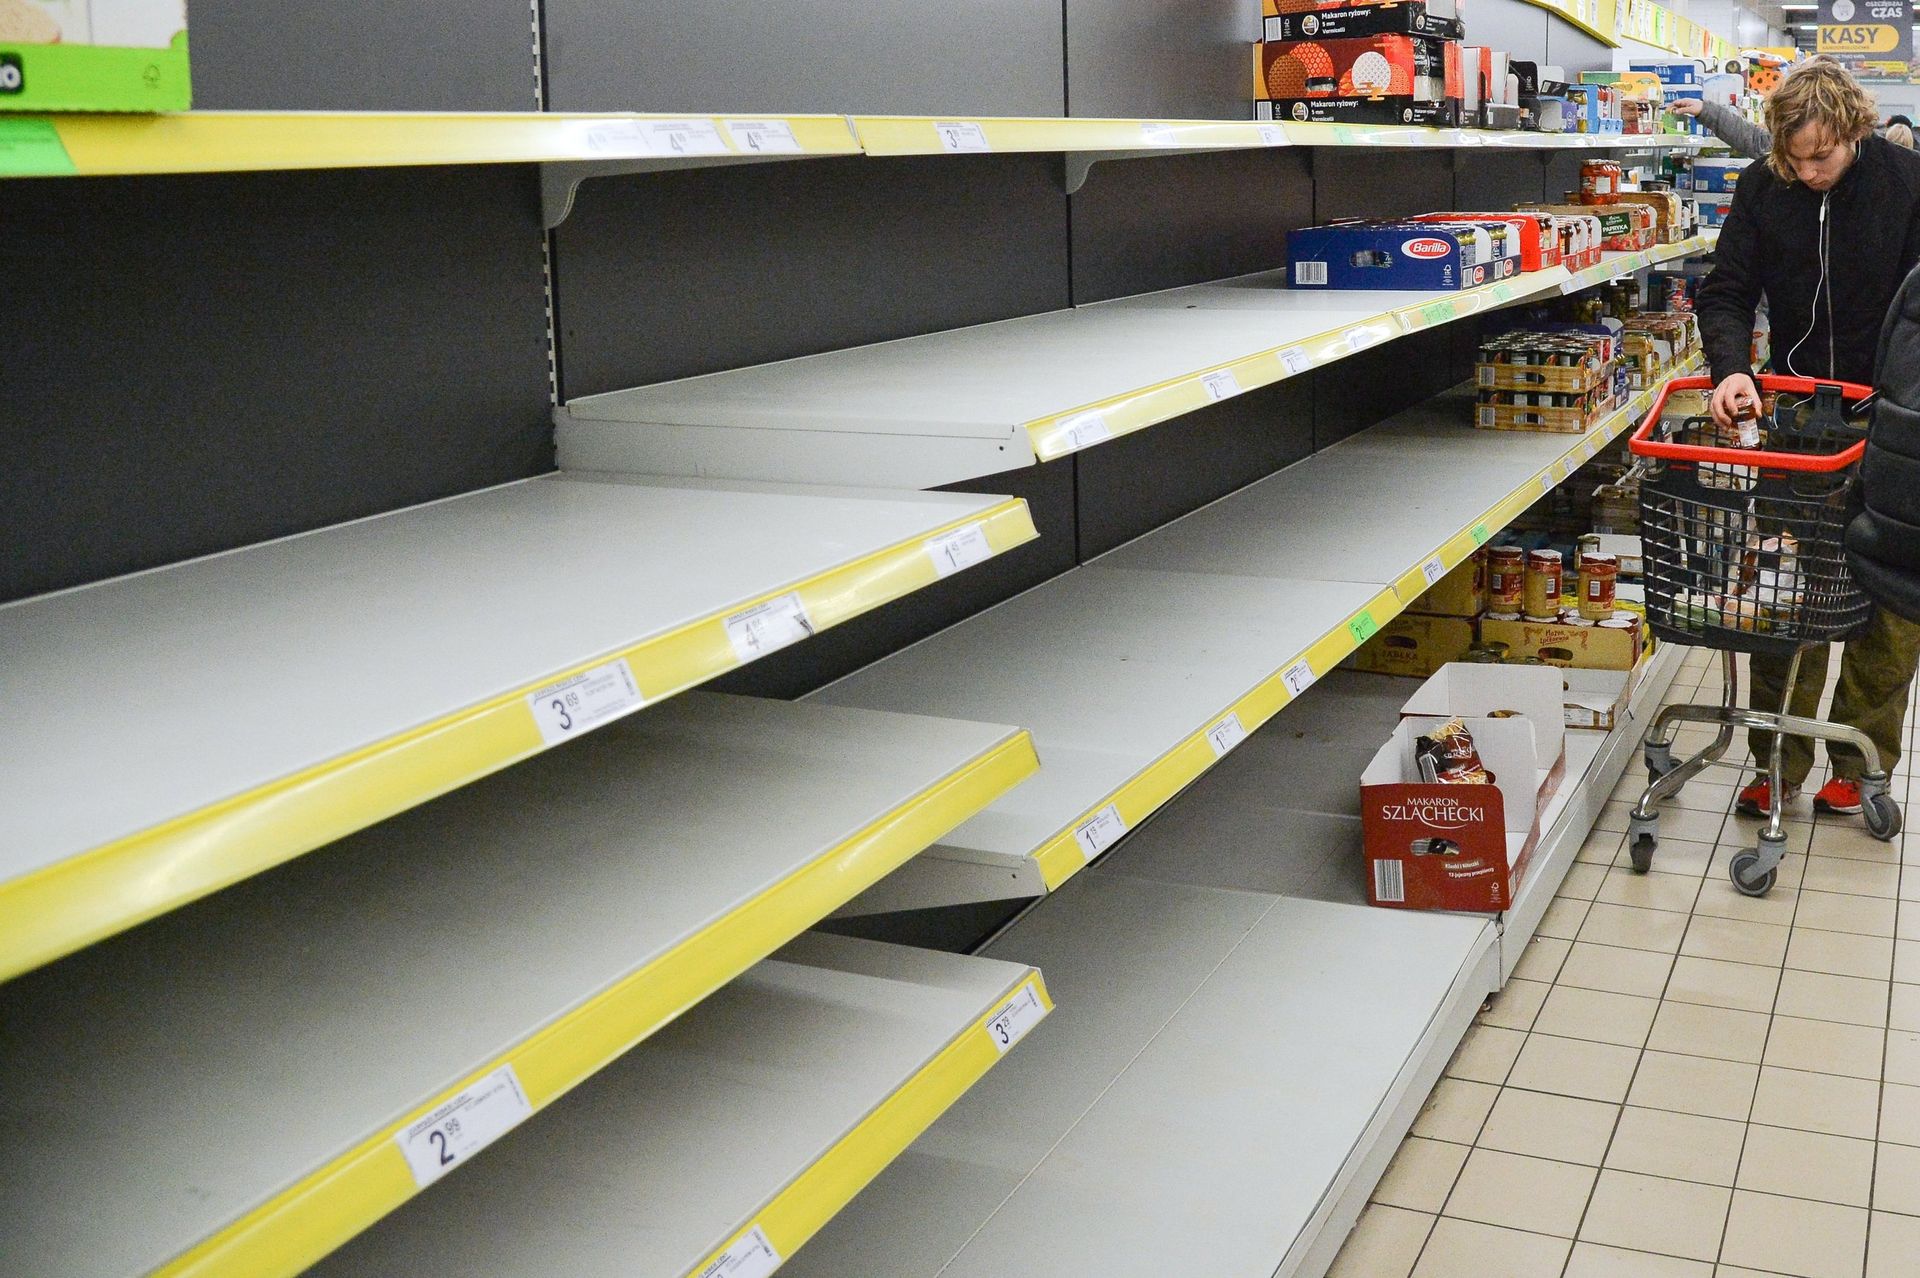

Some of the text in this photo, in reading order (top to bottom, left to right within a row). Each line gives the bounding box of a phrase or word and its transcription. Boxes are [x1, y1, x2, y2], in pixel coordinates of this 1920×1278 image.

[1322, 10, 1347, 20] Makaron
[1871, 8, 1902, 18] CZAS
[1822, 28, 1878, 44] KASY
[1336, 100, 1358, 108] ryżowy:
[1602, 224, 1628, 232] PAPRYKA
[1412, 242, 1446, 253] Barilla
[552, 700, 572, 730] 3
[1406, 797, 1458, 806] MAKARON
[1382, 805, 1484, 824] SZLACHECKI
[996, 1023, 1009, 1044] 3
[429, 1130, 455, 1166] 2
